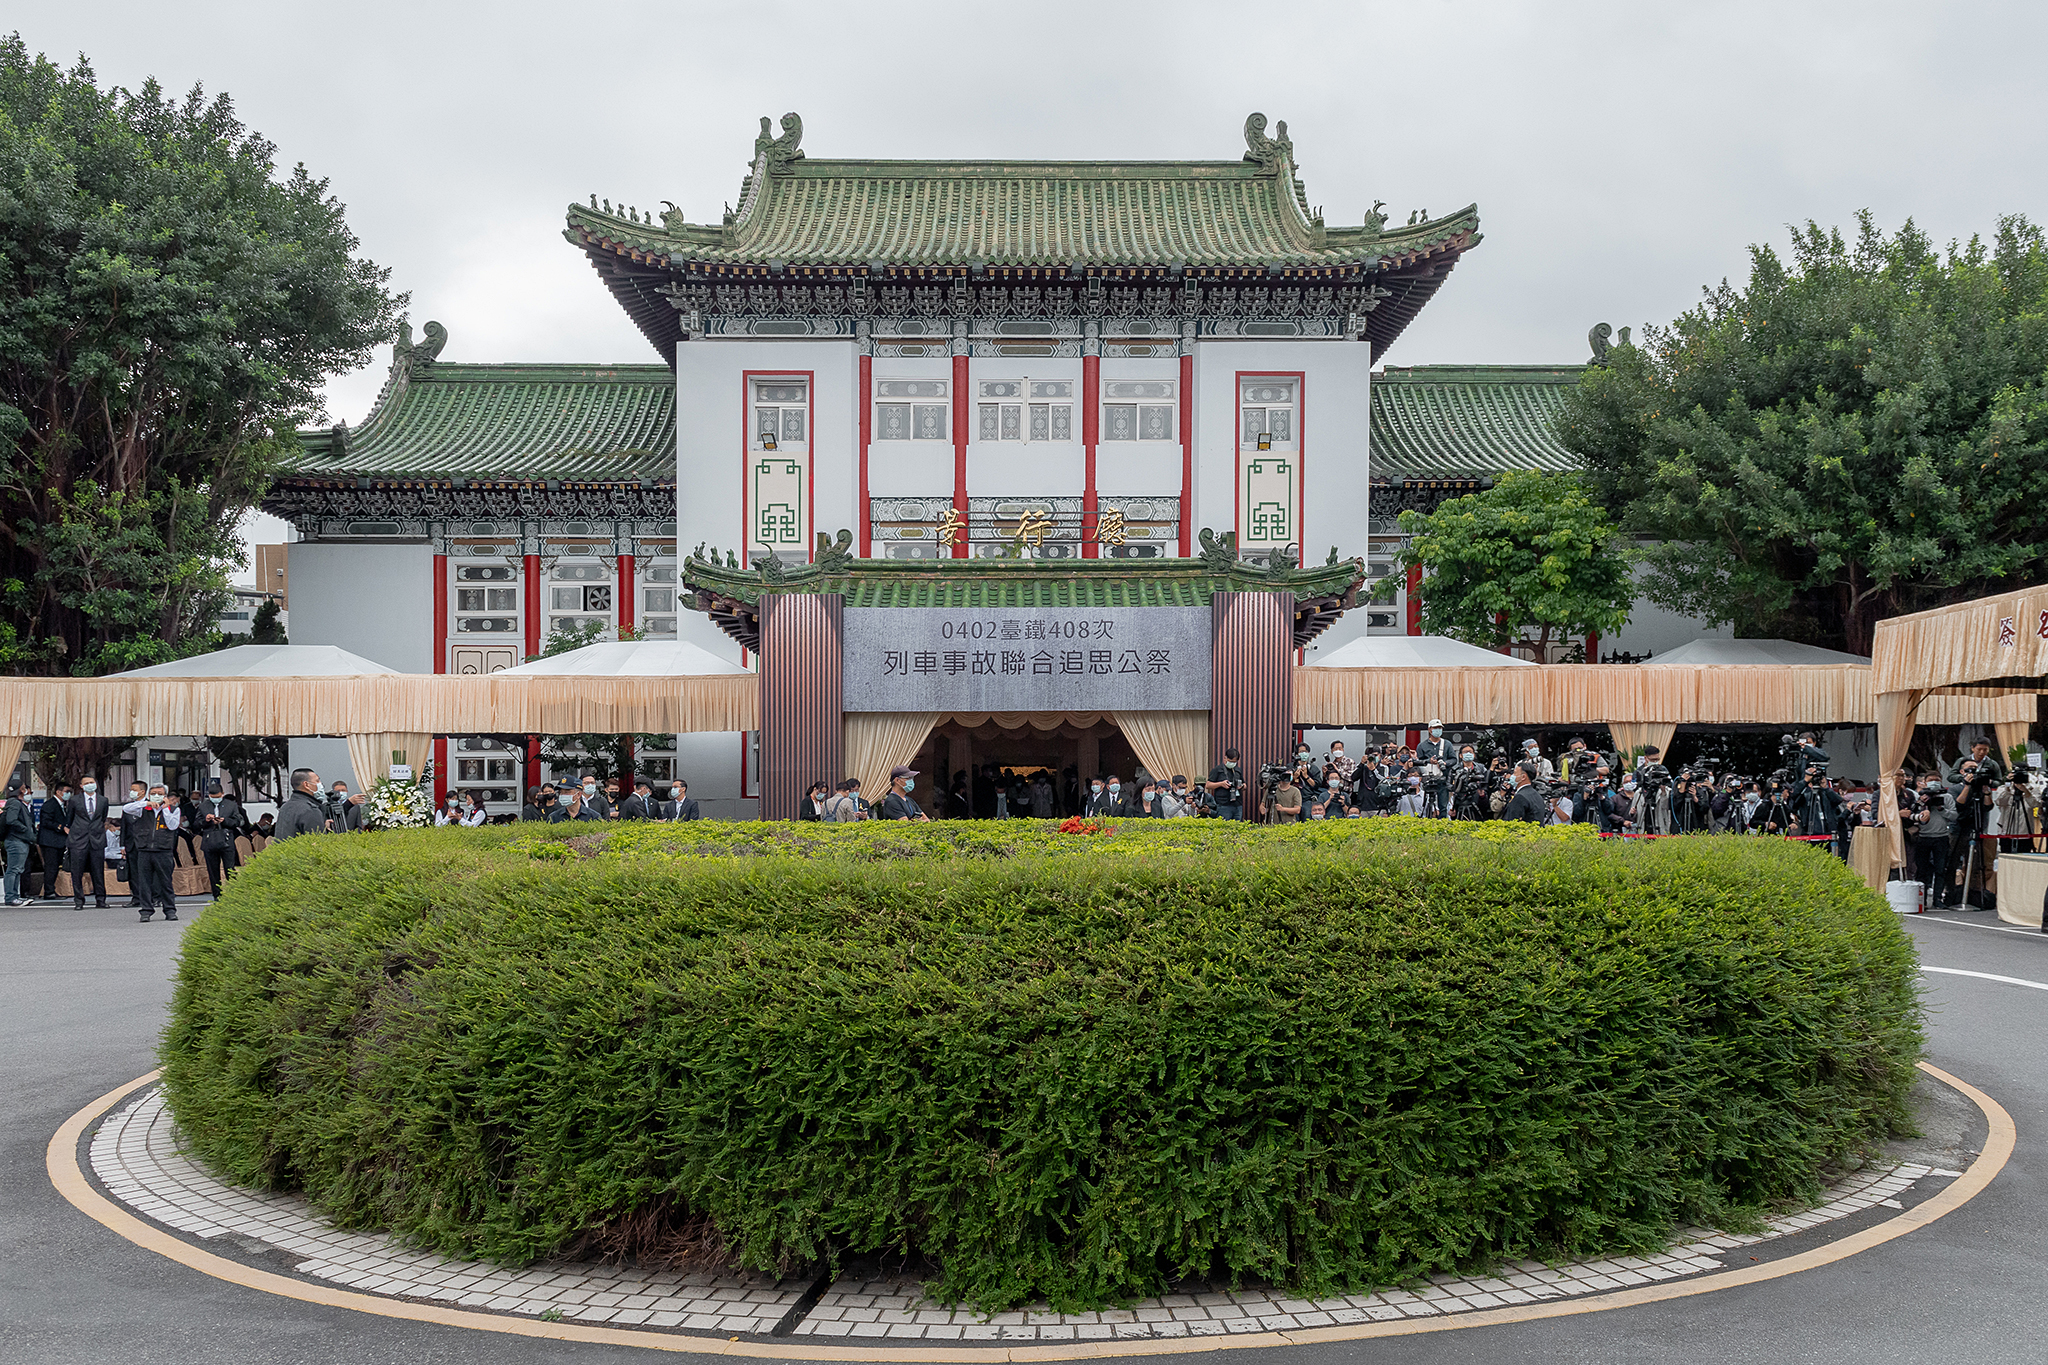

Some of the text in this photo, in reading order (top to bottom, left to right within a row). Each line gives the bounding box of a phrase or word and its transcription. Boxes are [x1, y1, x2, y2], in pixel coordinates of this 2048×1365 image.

[941, 618, 1115, 641] 0402臺鐵408次
[883, 649, 1173, 677] 列車事故聯合追思公祭
